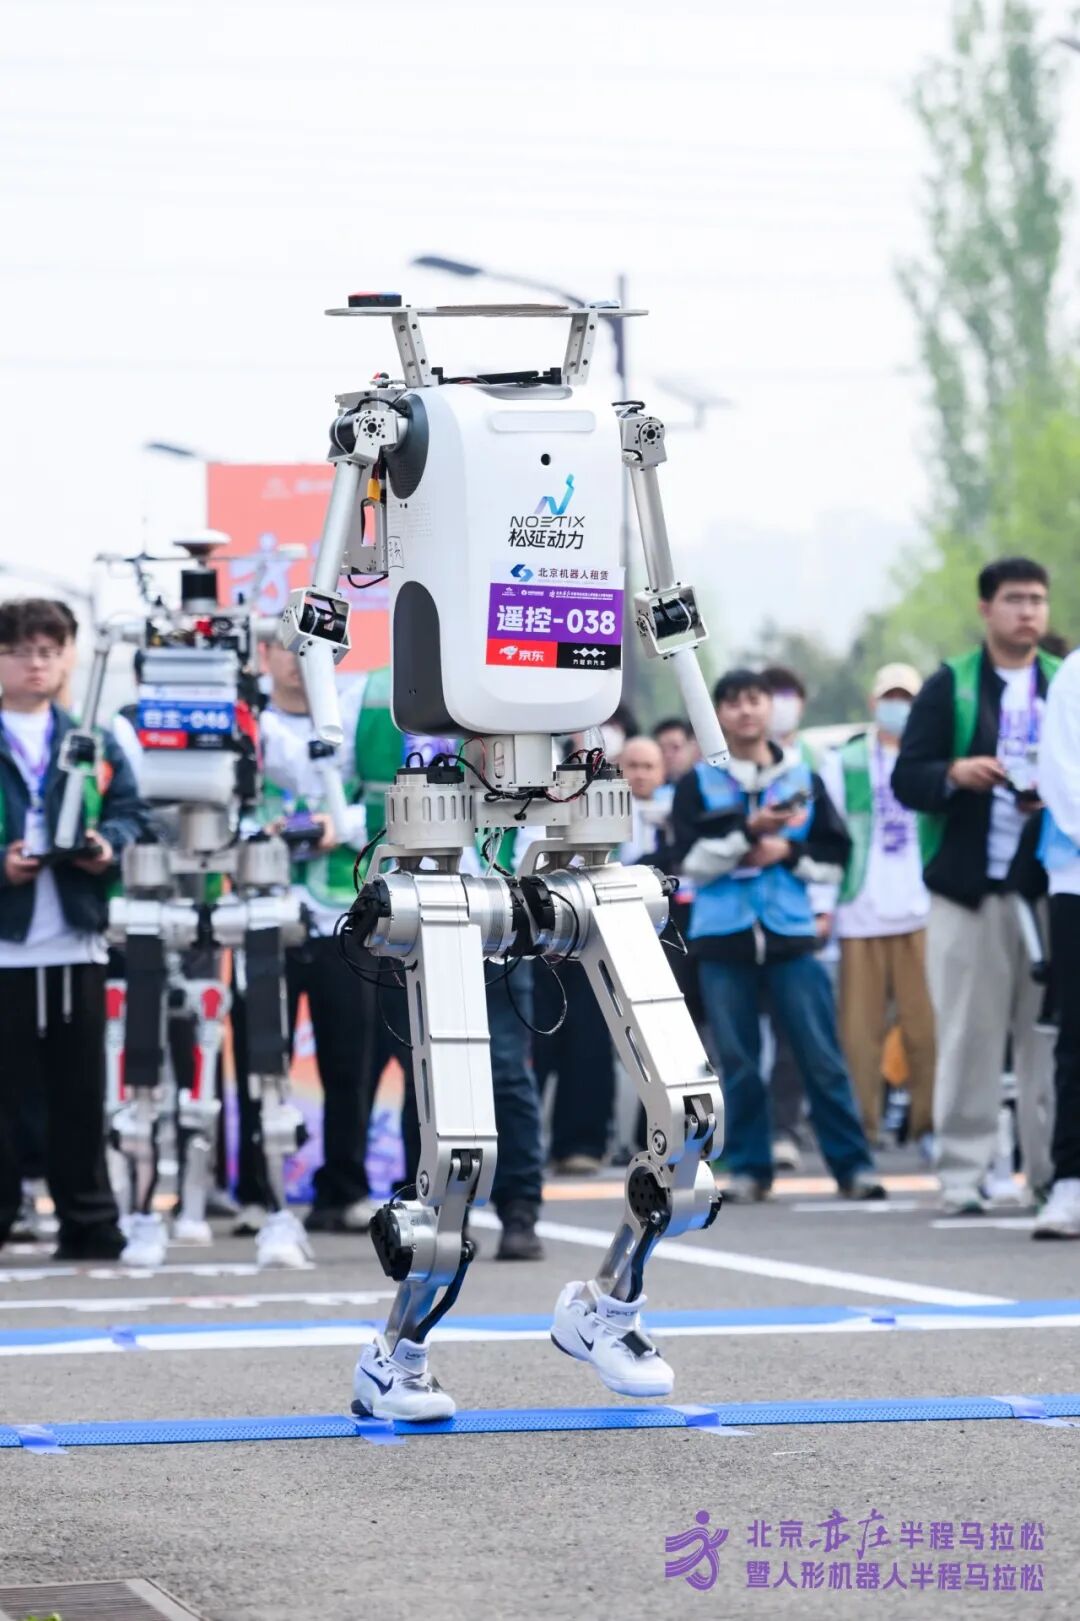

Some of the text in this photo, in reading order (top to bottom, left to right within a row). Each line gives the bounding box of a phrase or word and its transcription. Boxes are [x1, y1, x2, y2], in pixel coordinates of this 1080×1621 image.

[510, 516, 585, 528] NOETIX
[508, 528, 584, 550] 松延动力
[538, 567, 609, 581] 北京机器人租赁
[497, 605, 616, 635] 遥控-038
[519, 650, 544, 662] 京东
